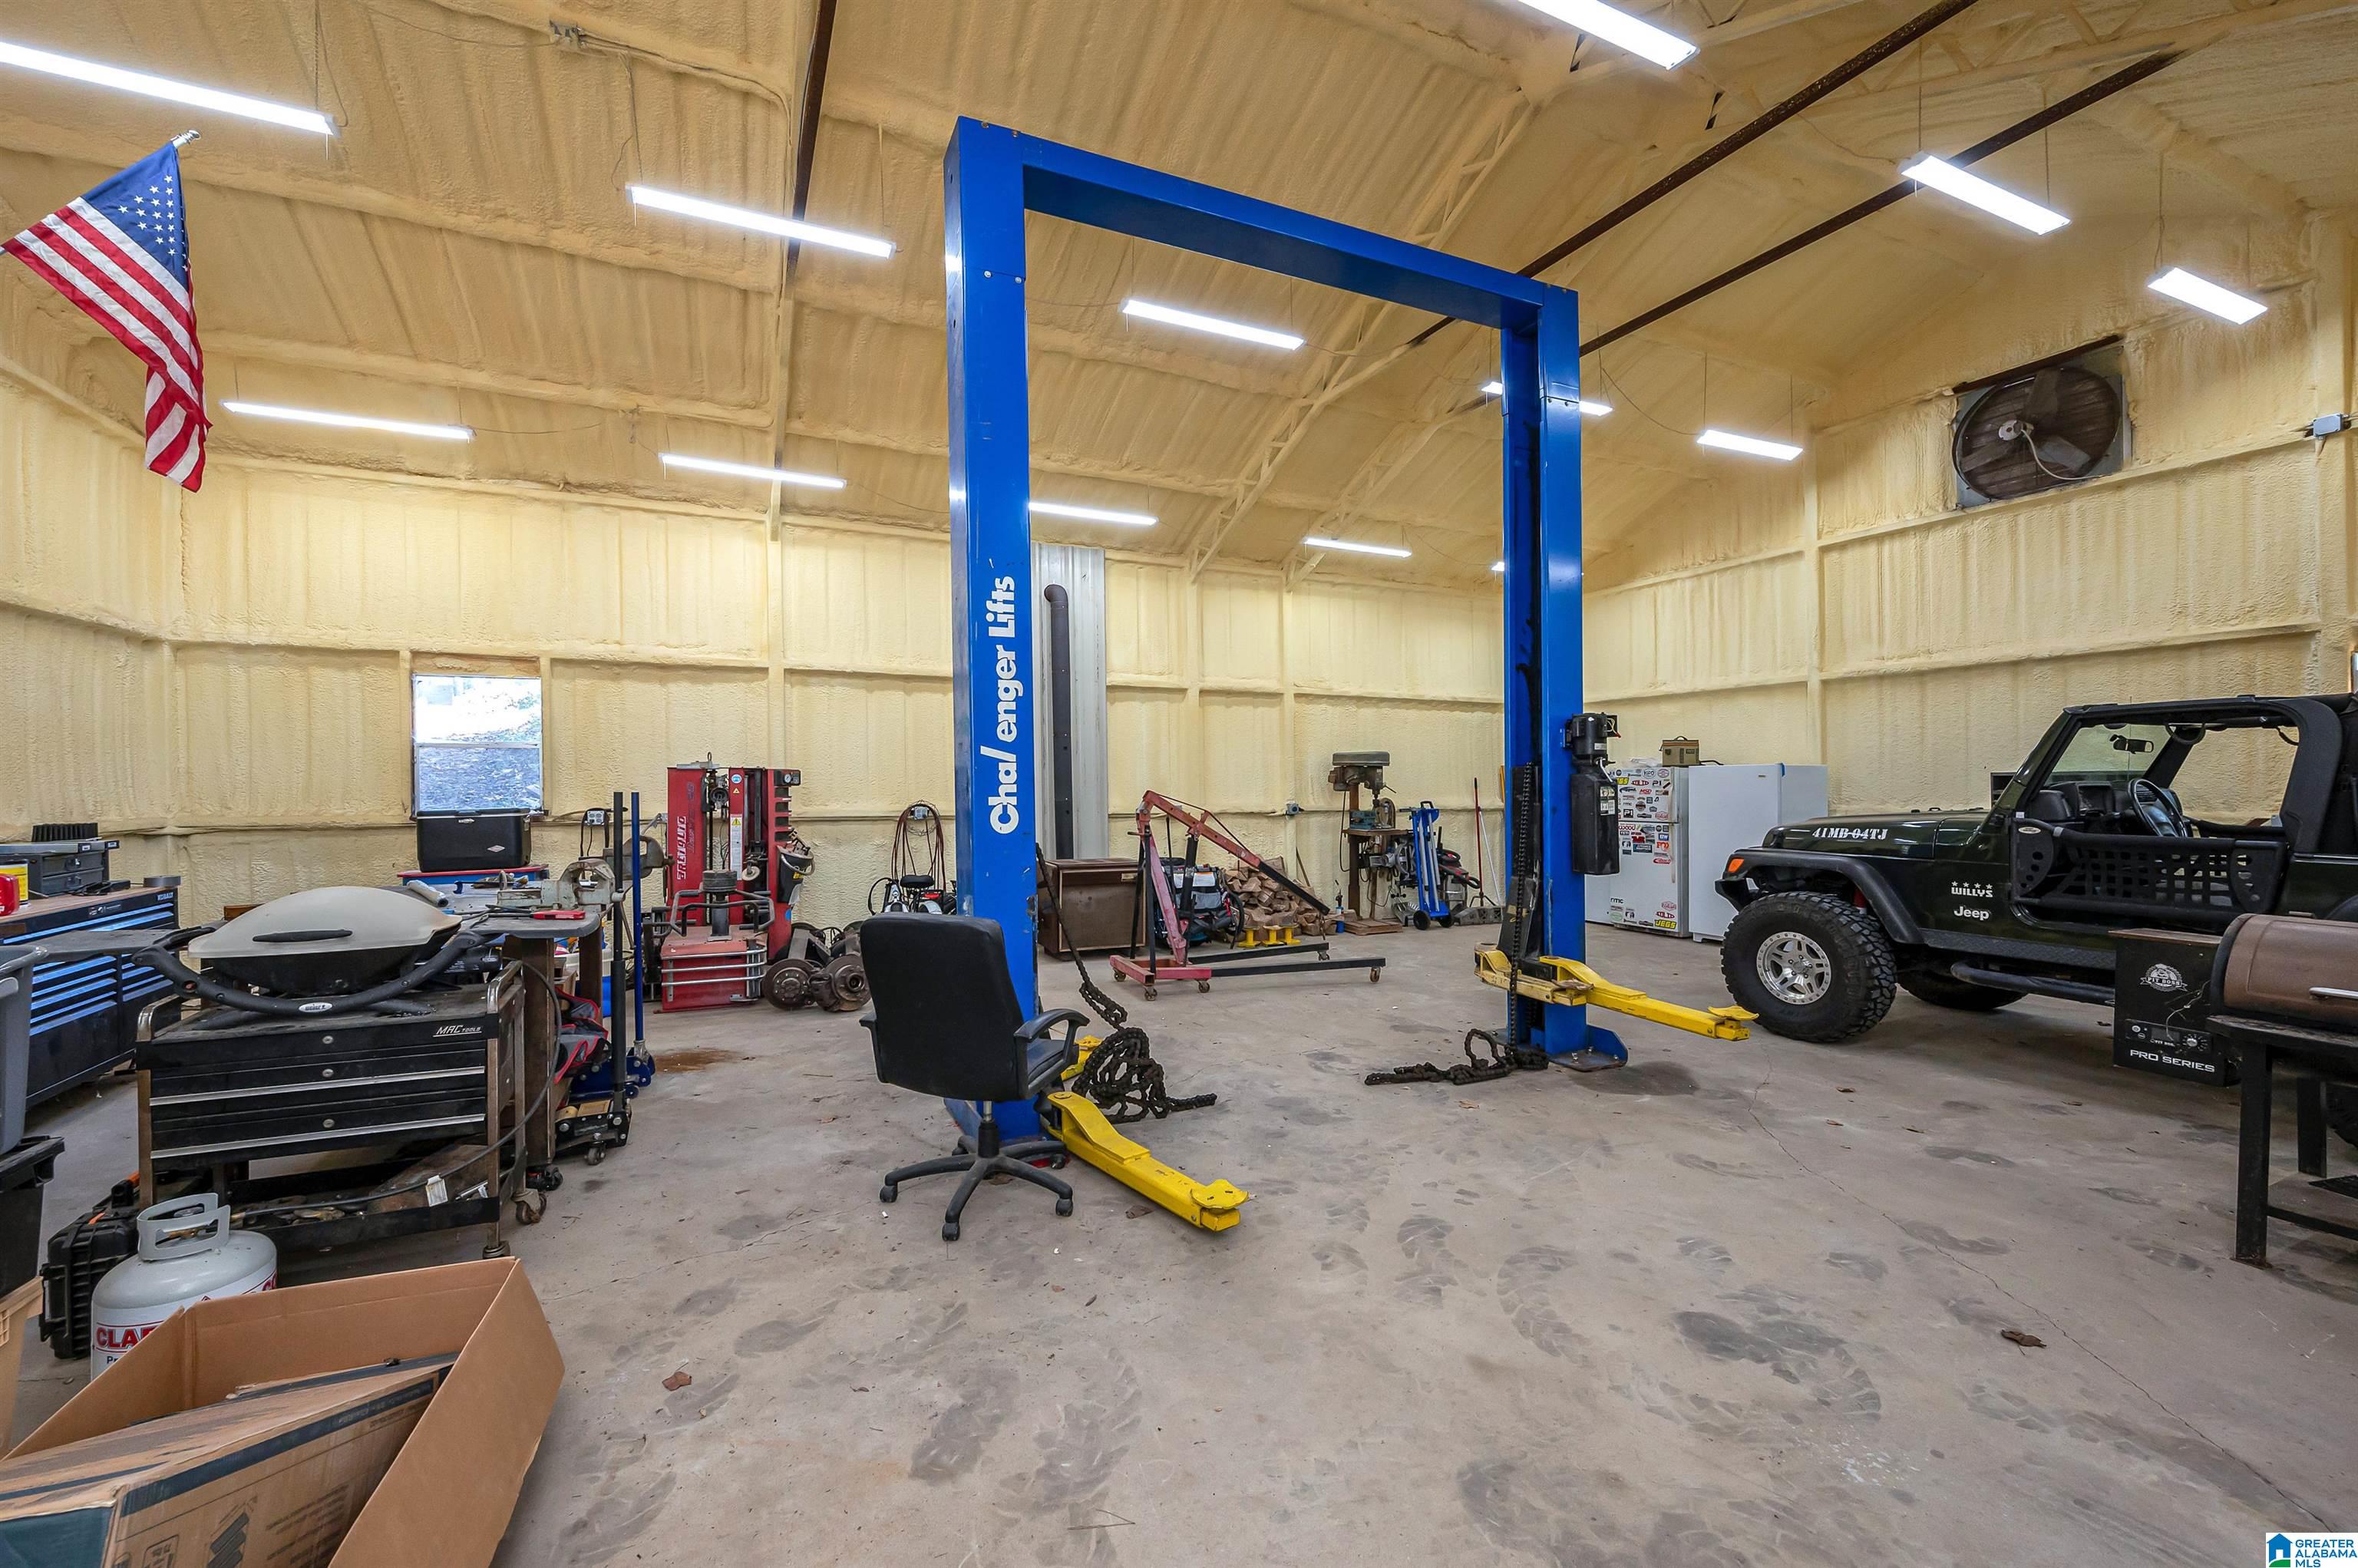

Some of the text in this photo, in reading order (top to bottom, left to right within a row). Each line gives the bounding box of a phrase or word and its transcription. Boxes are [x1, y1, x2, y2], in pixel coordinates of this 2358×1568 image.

[986, 576, 1015, 638] Lifts
[1951, 886, 1993, 898] WILLYS
[1953, 906, 1990, 921] Jeep
[435, 1025, 464, 1035] MAC
[2130, 1049, 2215, 1073] PRO SERIES
